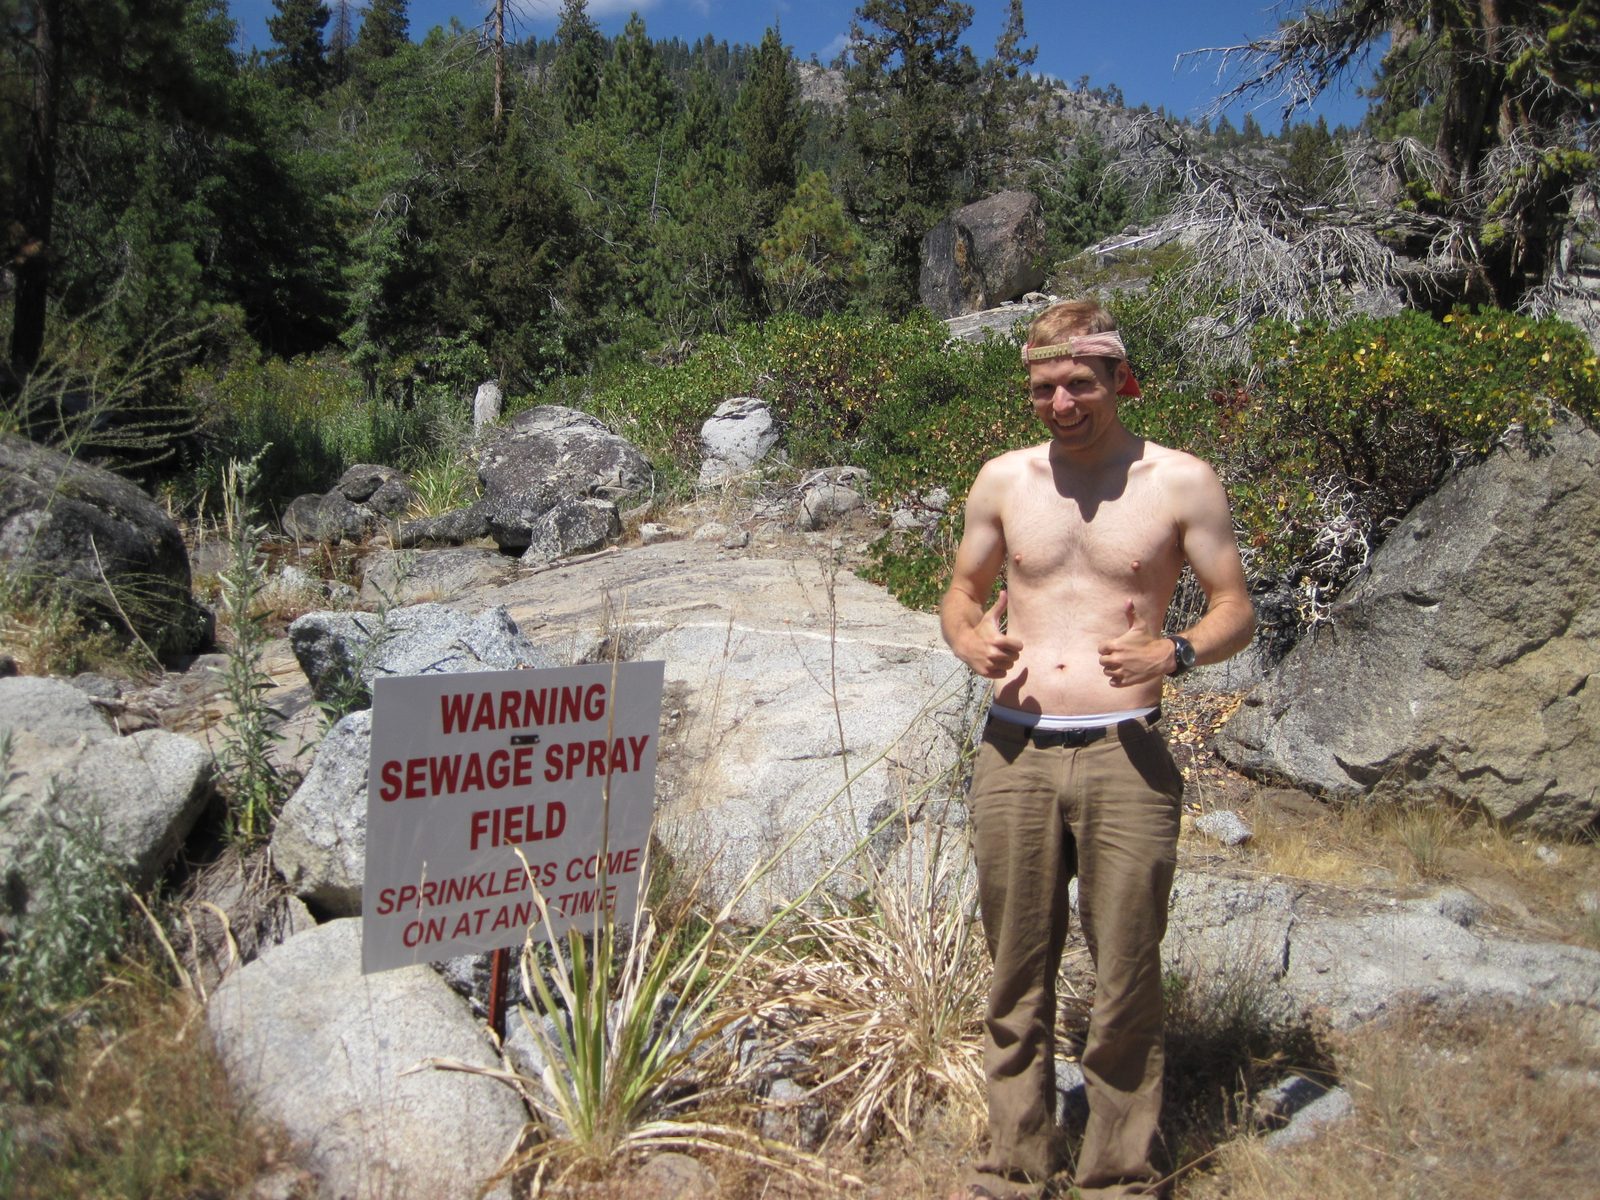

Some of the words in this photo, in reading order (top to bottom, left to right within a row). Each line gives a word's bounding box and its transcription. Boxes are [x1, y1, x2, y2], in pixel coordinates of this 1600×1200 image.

[440, 683, 606, 735] WARNING
[379, 746, 534, 803] SEWAGE
[543, 734, 650, 783] SPRAY
[470, 801, 567, 850] FIELD
[376, 862, 558, 915] SPRINKLERS
[566, 848, 640, 882] COME
[402, 916, 447, 948] ON
[451, 908, 491, 939] AT
[558, 885, 617, 918] TIME
